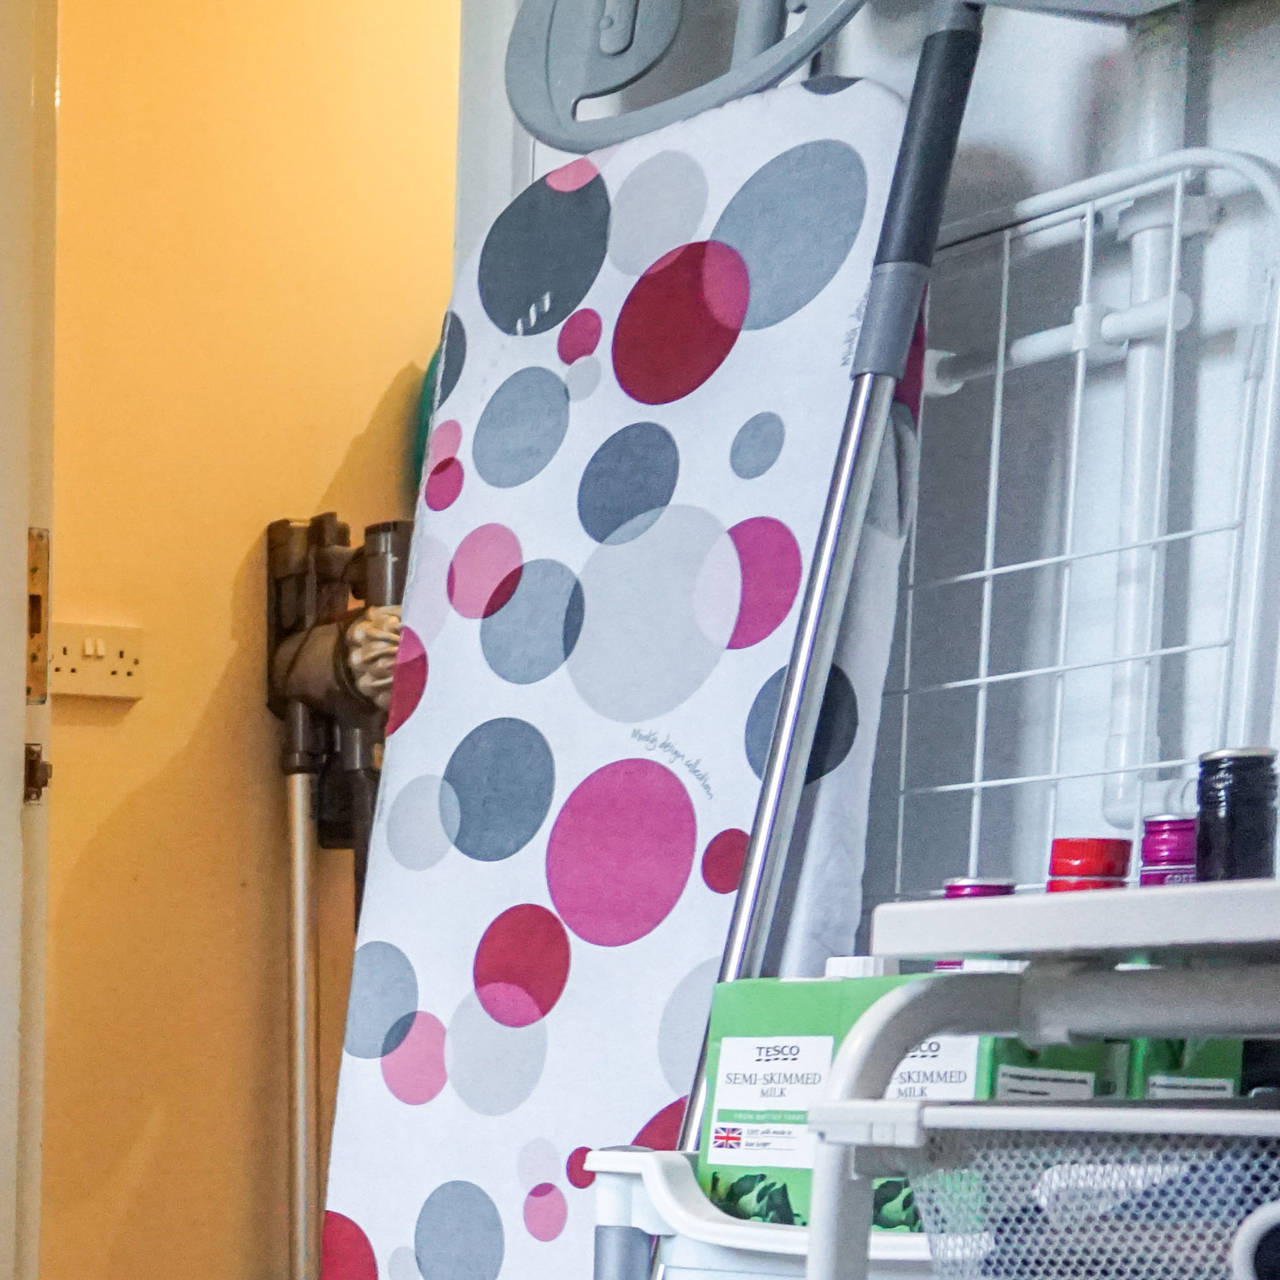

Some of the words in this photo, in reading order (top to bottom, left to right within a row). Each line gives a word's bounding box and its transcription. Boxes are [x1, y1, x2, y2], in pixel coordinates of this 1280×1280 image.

[756, 1045, 800, 1057] TESCO
[725, 1072, 822, 1085] SEMI-SKIMMED
[894, 1070, 967, 1084] -SKIMMED
[760, 1087, 787, 1098] MILK
[897, 1086, 928, 1098] MILK
